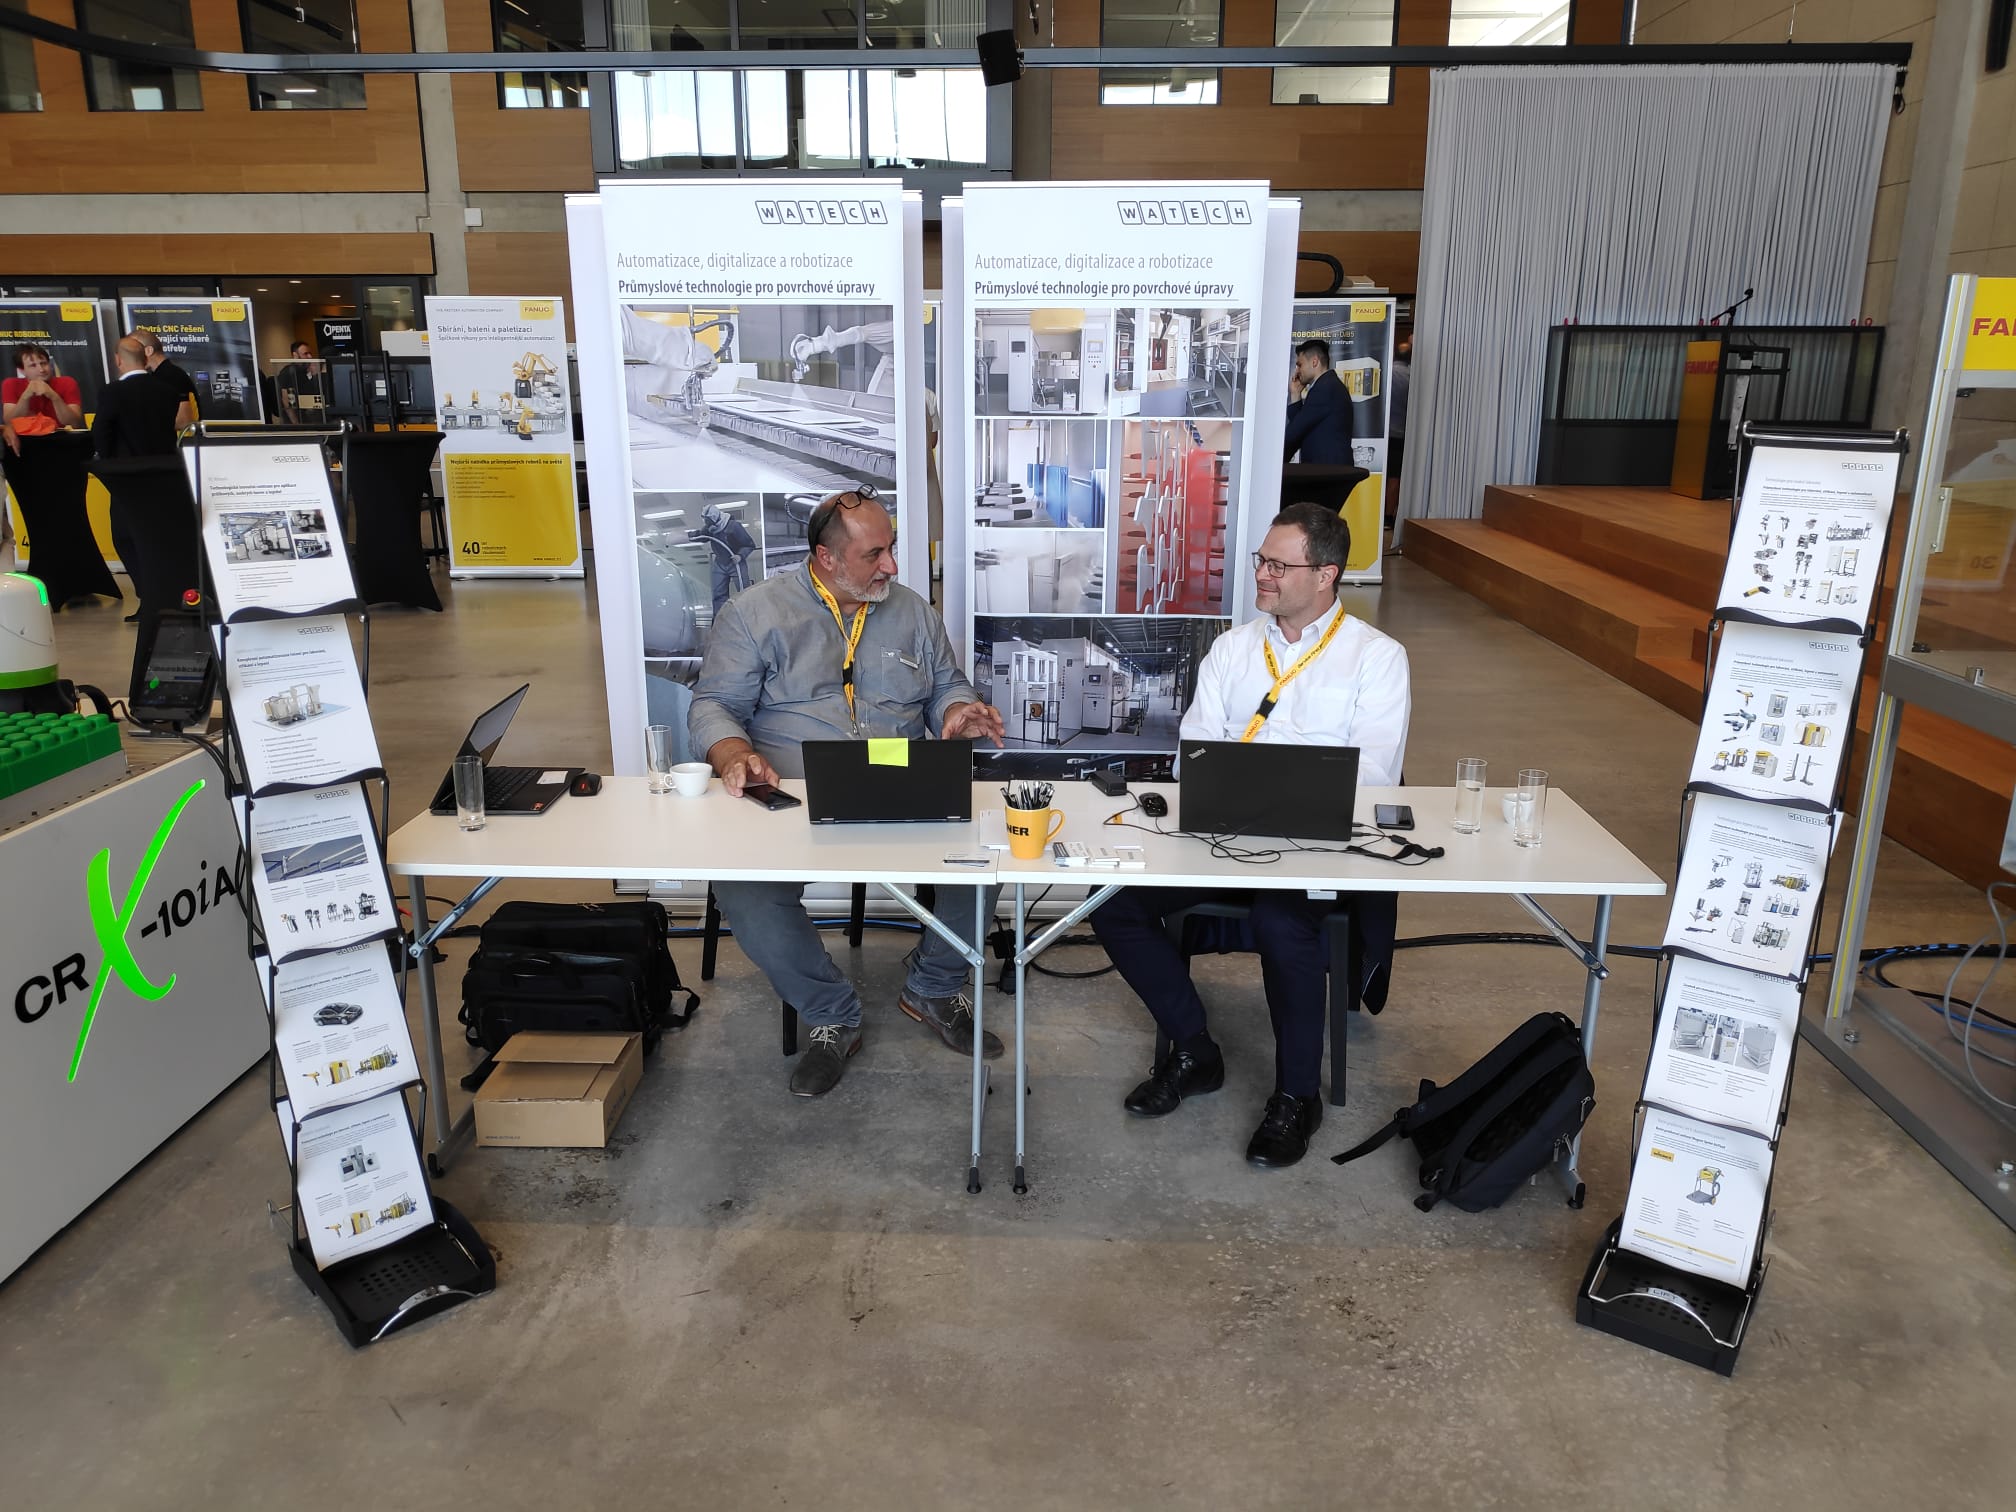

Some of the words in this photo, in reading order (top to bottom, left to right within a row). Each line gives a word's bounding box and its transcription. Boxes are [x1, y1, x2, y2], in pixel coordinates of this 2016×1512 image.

[760, 205, 882, 221] WATECH
[1122, 205, 1246, 221] WATECH
[616, 252, 704, 271] Automatizace,
[707, 252, 777, 272] digitalizace
[779, 257, 787, 268] a
[790, 252, 853, 268] robotizace
[974, 253, 1061, 271] Automatizace,
[1065, 253, 1135, 272] digitalizace
[1138, 258, 1145, 269] a
[1149, 253, 1213, 269] robotizace
[618, 279, 683, 296] Průmyslové
[686, 279, 752, 296] technologie
[755, 283, 774, 296] pro
[777, 279, 833, 296] povrchové
[836, 279, 875, 296] úpravy
[974, 280, 1038, 297] Průmyslové
[1042, 280, 1108, 297] technologie
[1111, 285, 1130, 297] pro
[1133, 280, 1191, 297] povrchové
[1194, 281, 1234, 297] úpravy
[162, 325, 179, 333] CNC
[162, 344, 187, 353] otřeby
[462, 541, 480, 554] 40
